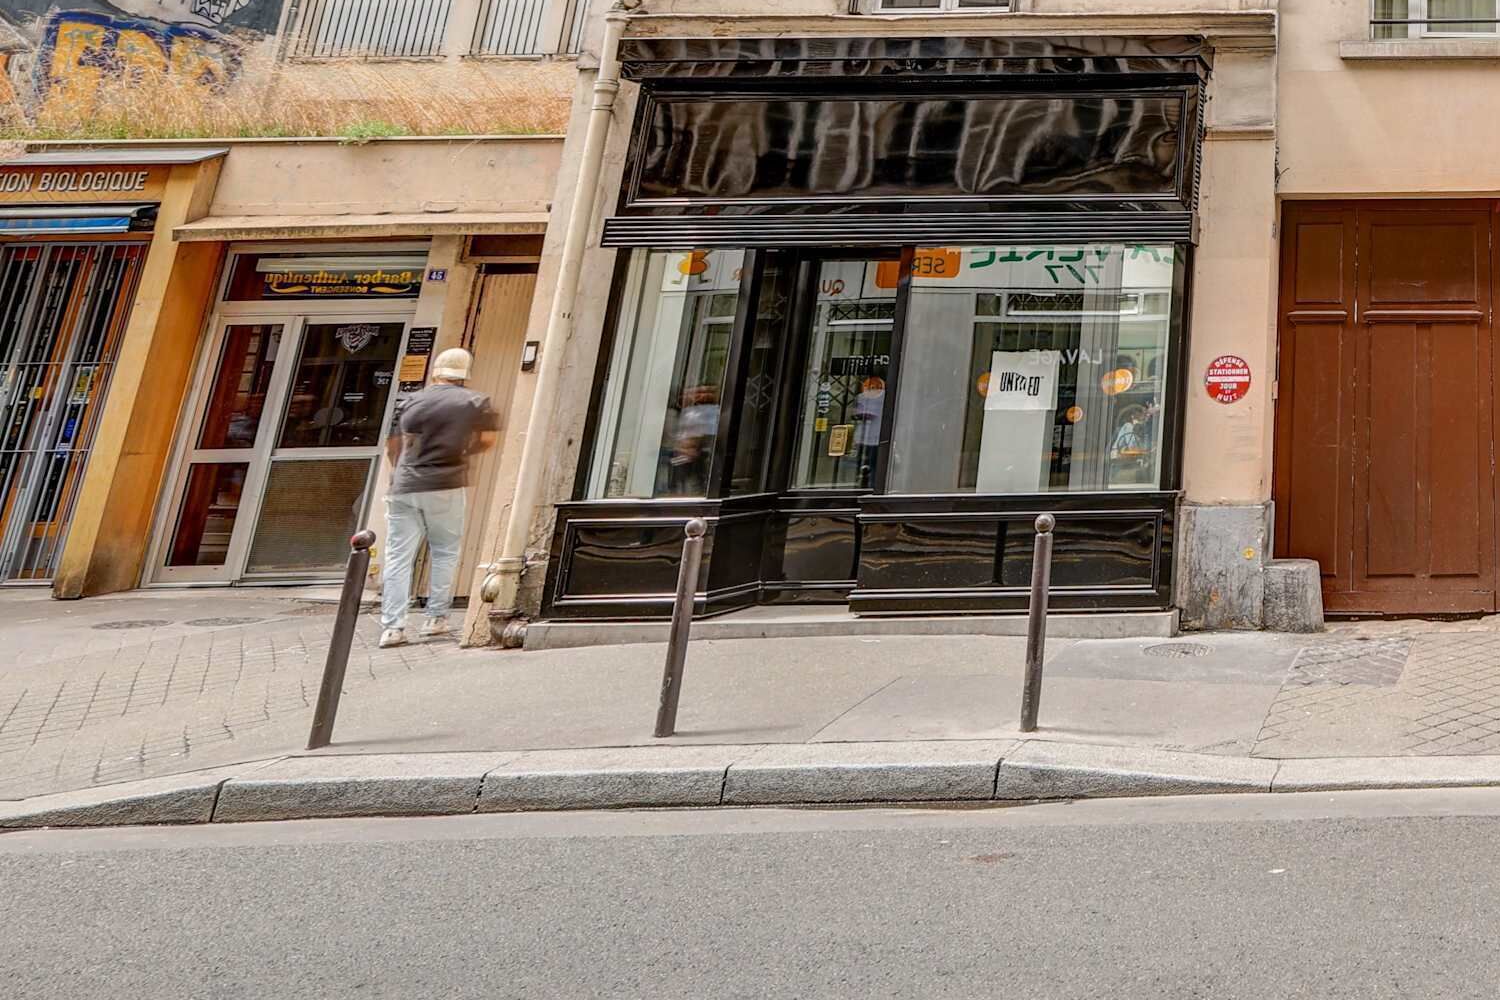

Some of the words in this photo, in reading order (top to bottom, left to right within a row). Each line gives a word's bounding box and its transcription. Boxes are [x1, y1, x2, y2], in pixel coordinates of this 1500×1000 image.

[37, 171, 148, 192] BIOLOGIQUE
[1209, 368, 1249, 376] STATIONNER
[1216, 392, 1238, 402] NUIT
